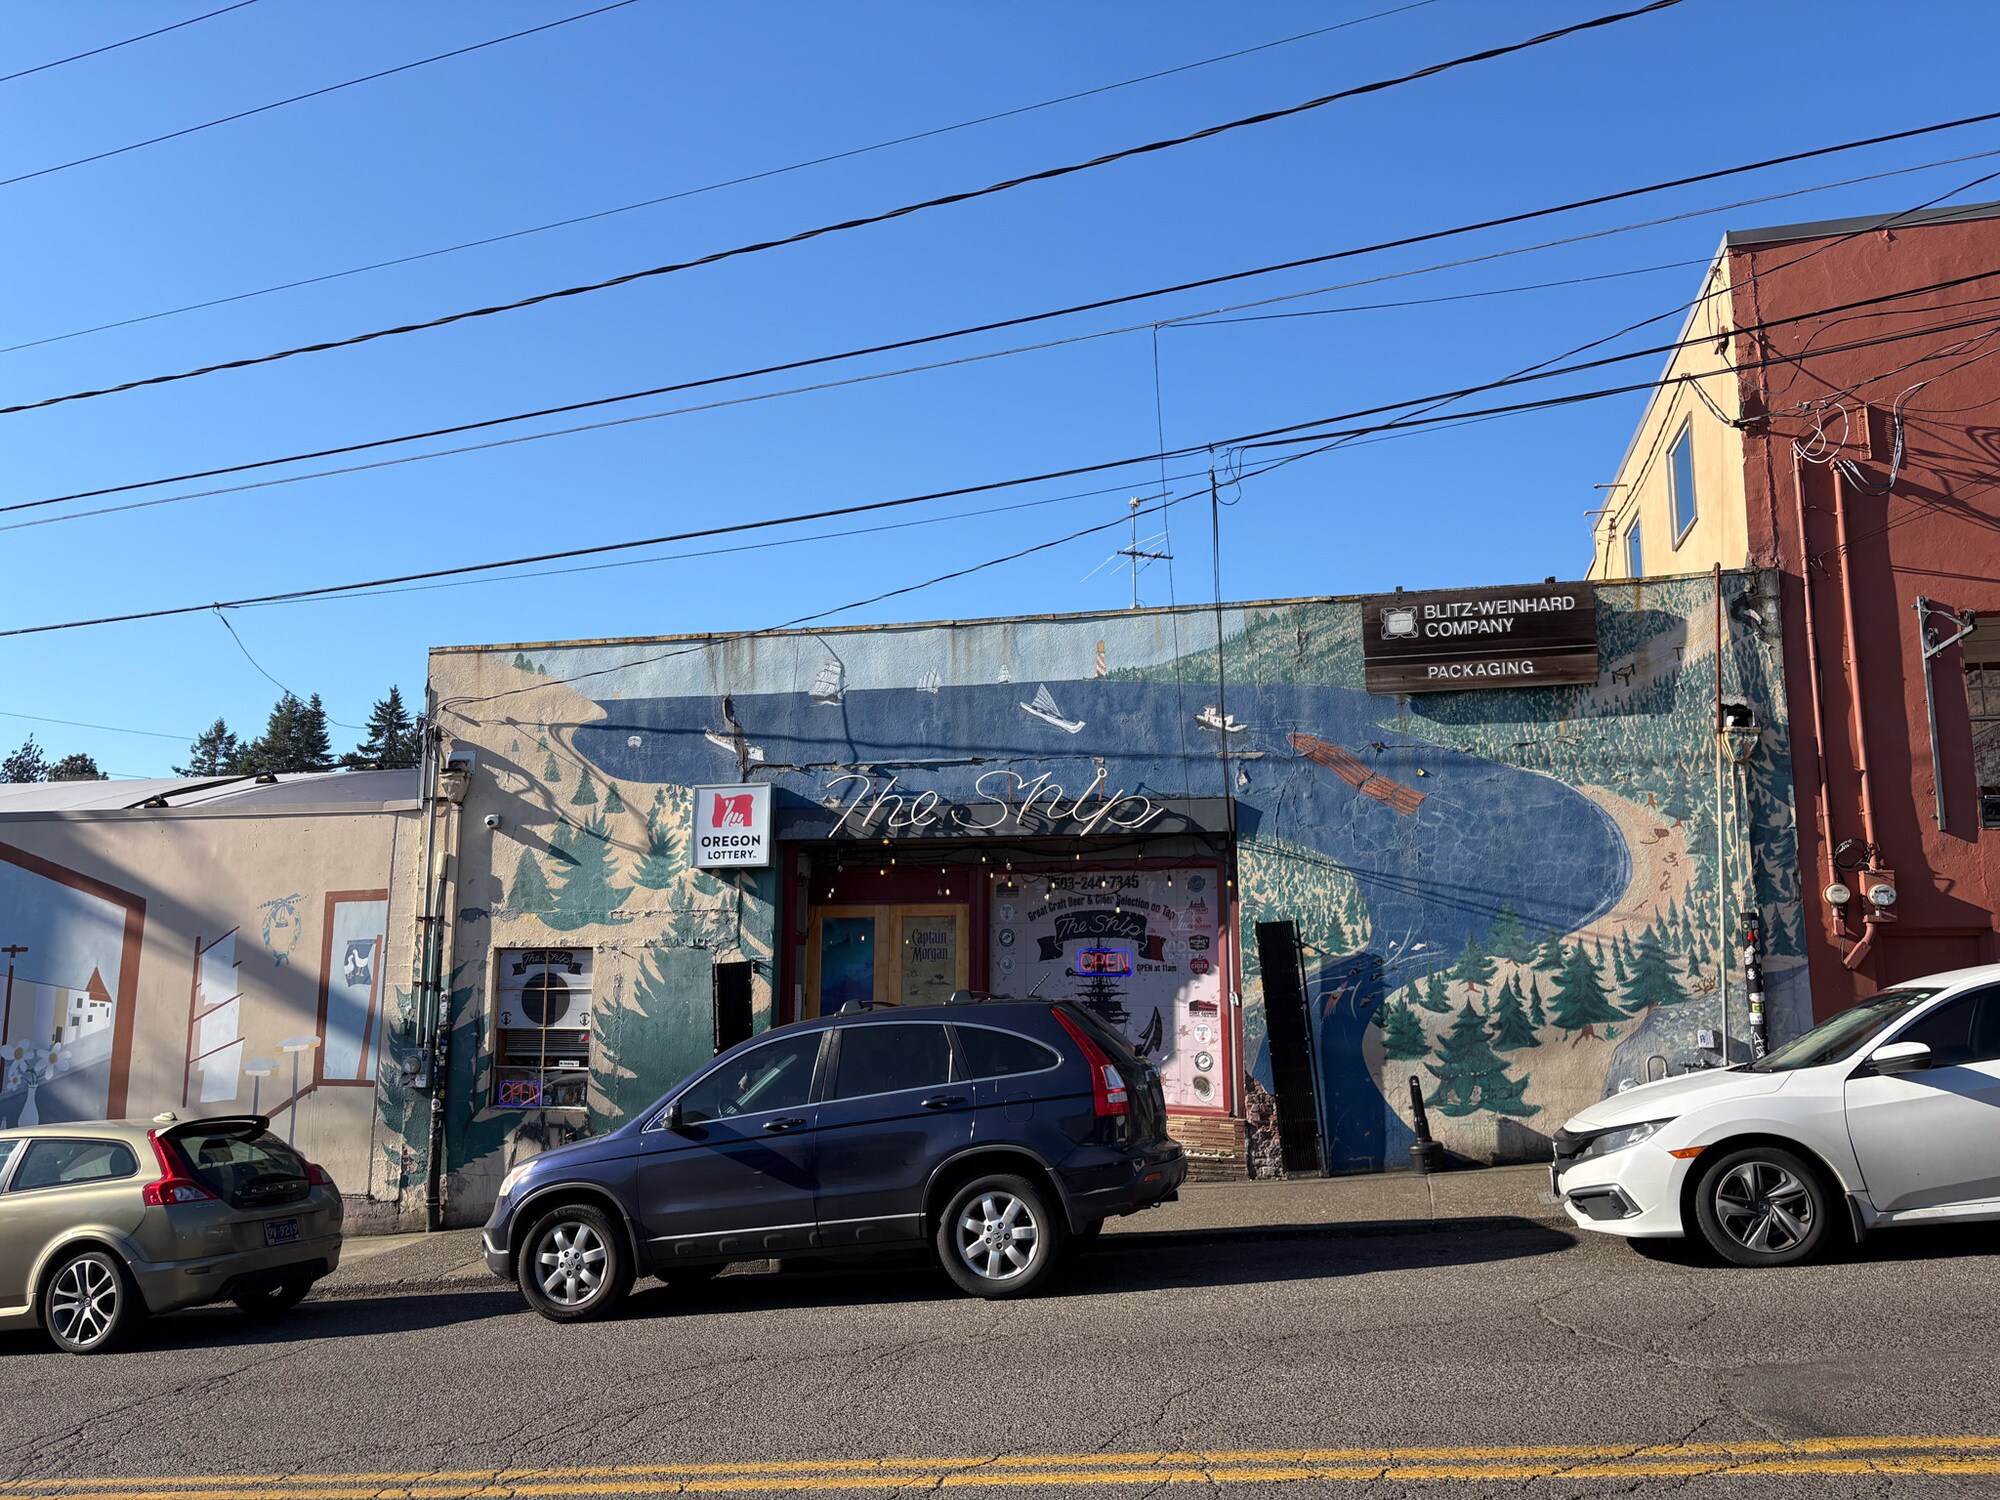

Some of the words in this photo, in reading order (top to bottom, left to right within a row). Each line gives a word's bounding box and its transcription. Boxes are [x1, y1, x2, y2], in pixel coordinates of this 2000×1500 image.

[1424, 596, 1575, 619] BLITZ-WEINHARD
[1425, 618, 1514, 638] COMPANY
[1427, 660, 1534, 679] PACKAGING
[826, 774, 940, 838] The
[951, 766, 1165, 837] Ship
[701, 835, 761, 847] OREGON
[707, 850, 755, 859] LOTTERY
[1027, 905, 1048, 921] Great
[1048, 898, 1066, 912] Craft
[1067, 897, 1085, 907] Beer
[1087, 894, 1093, 904] &
[1116, 894, 1150, 910] Selection
[1150, 903, 1161, 913] on
[1162, 905, 1176, 920] Tap
[1056, 917, 1087, 939] The
[1089, 915, 1143, 936] Ship
[911, 928, 947, 947] Captain
[522, 953, 540, 964] The
[541, 952, 571, 964] Ship
[911, 947, 948, 963] Morgan
[1080, 953, 1130, 972] OPEN
[501, 1082, 540, 1103] OPEN
[235, 1183, 297, 1196] VOLVO
